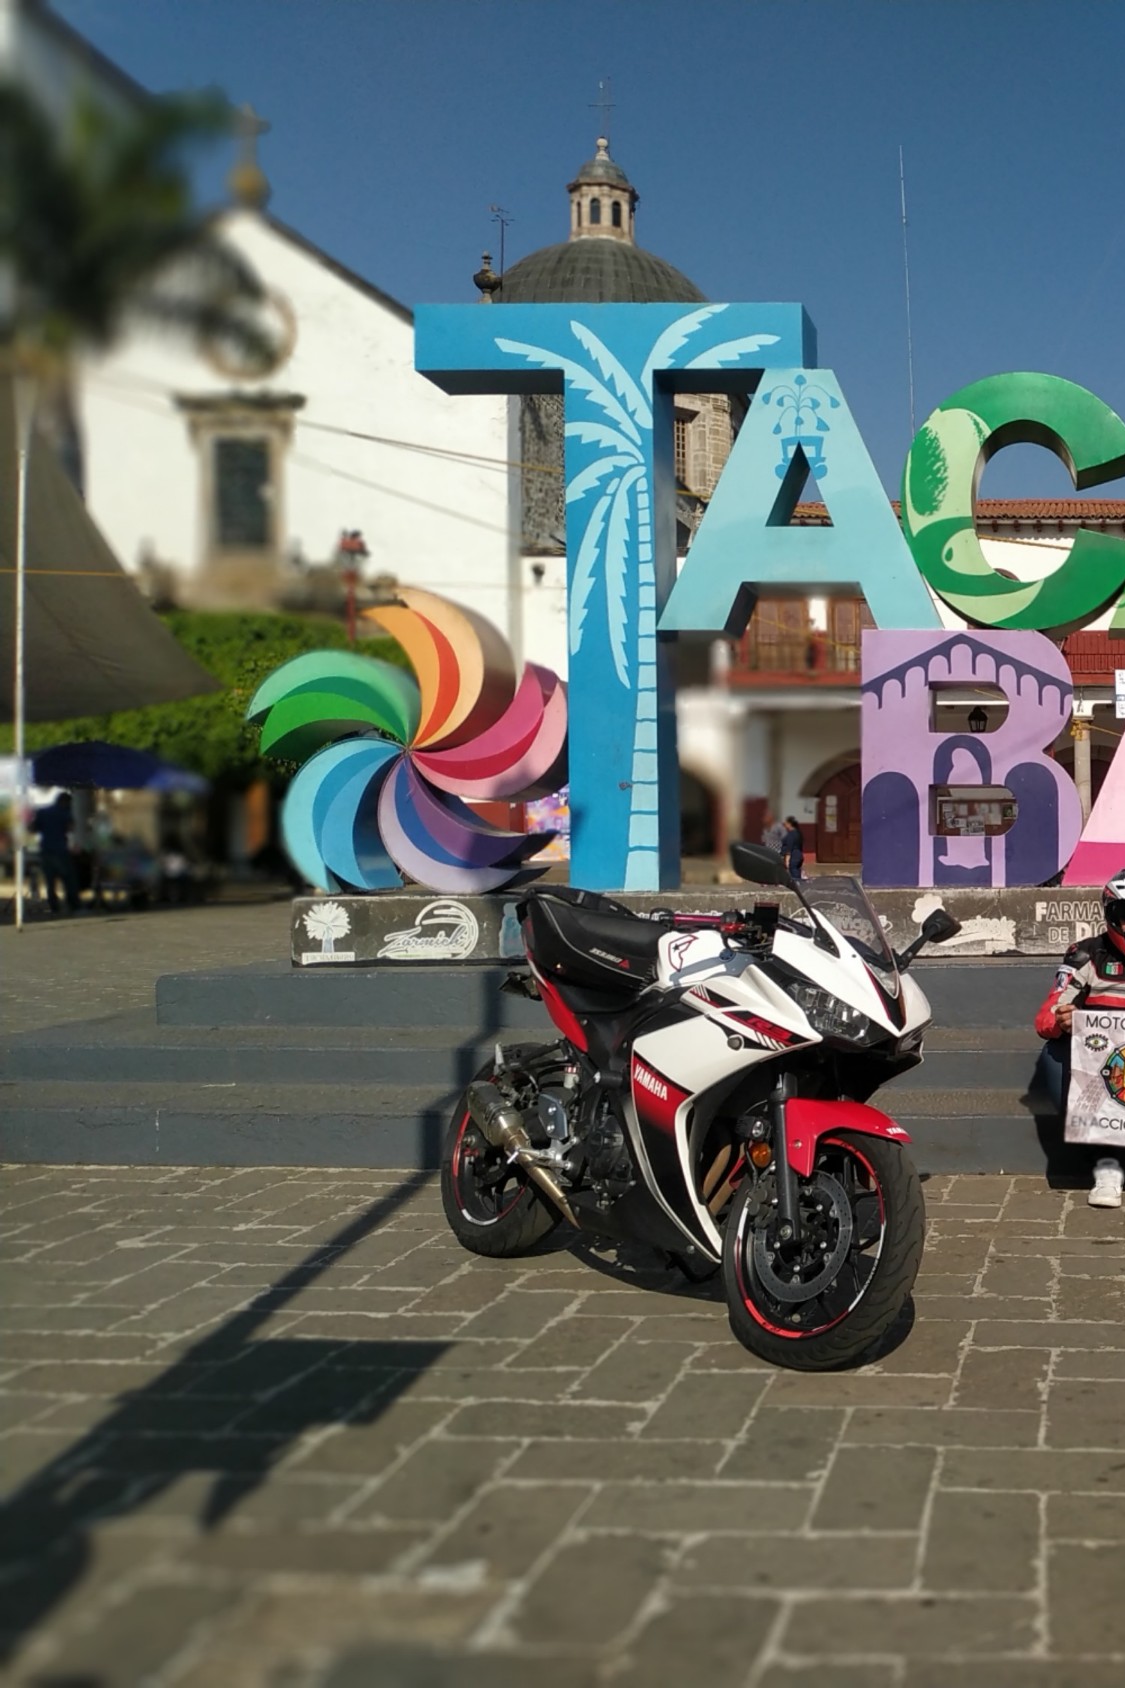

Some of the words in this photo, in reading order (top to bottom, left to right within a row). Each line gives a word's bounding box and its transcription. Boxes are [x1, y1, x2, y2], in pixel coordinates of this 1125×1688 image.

[1035, 901, 1104, 922] FARMA
[1048, 927, 1070, 944] DE
[633, 1063, 668, 1102] YAMAHA
[1070, 1115, 1087, 1127] EN
